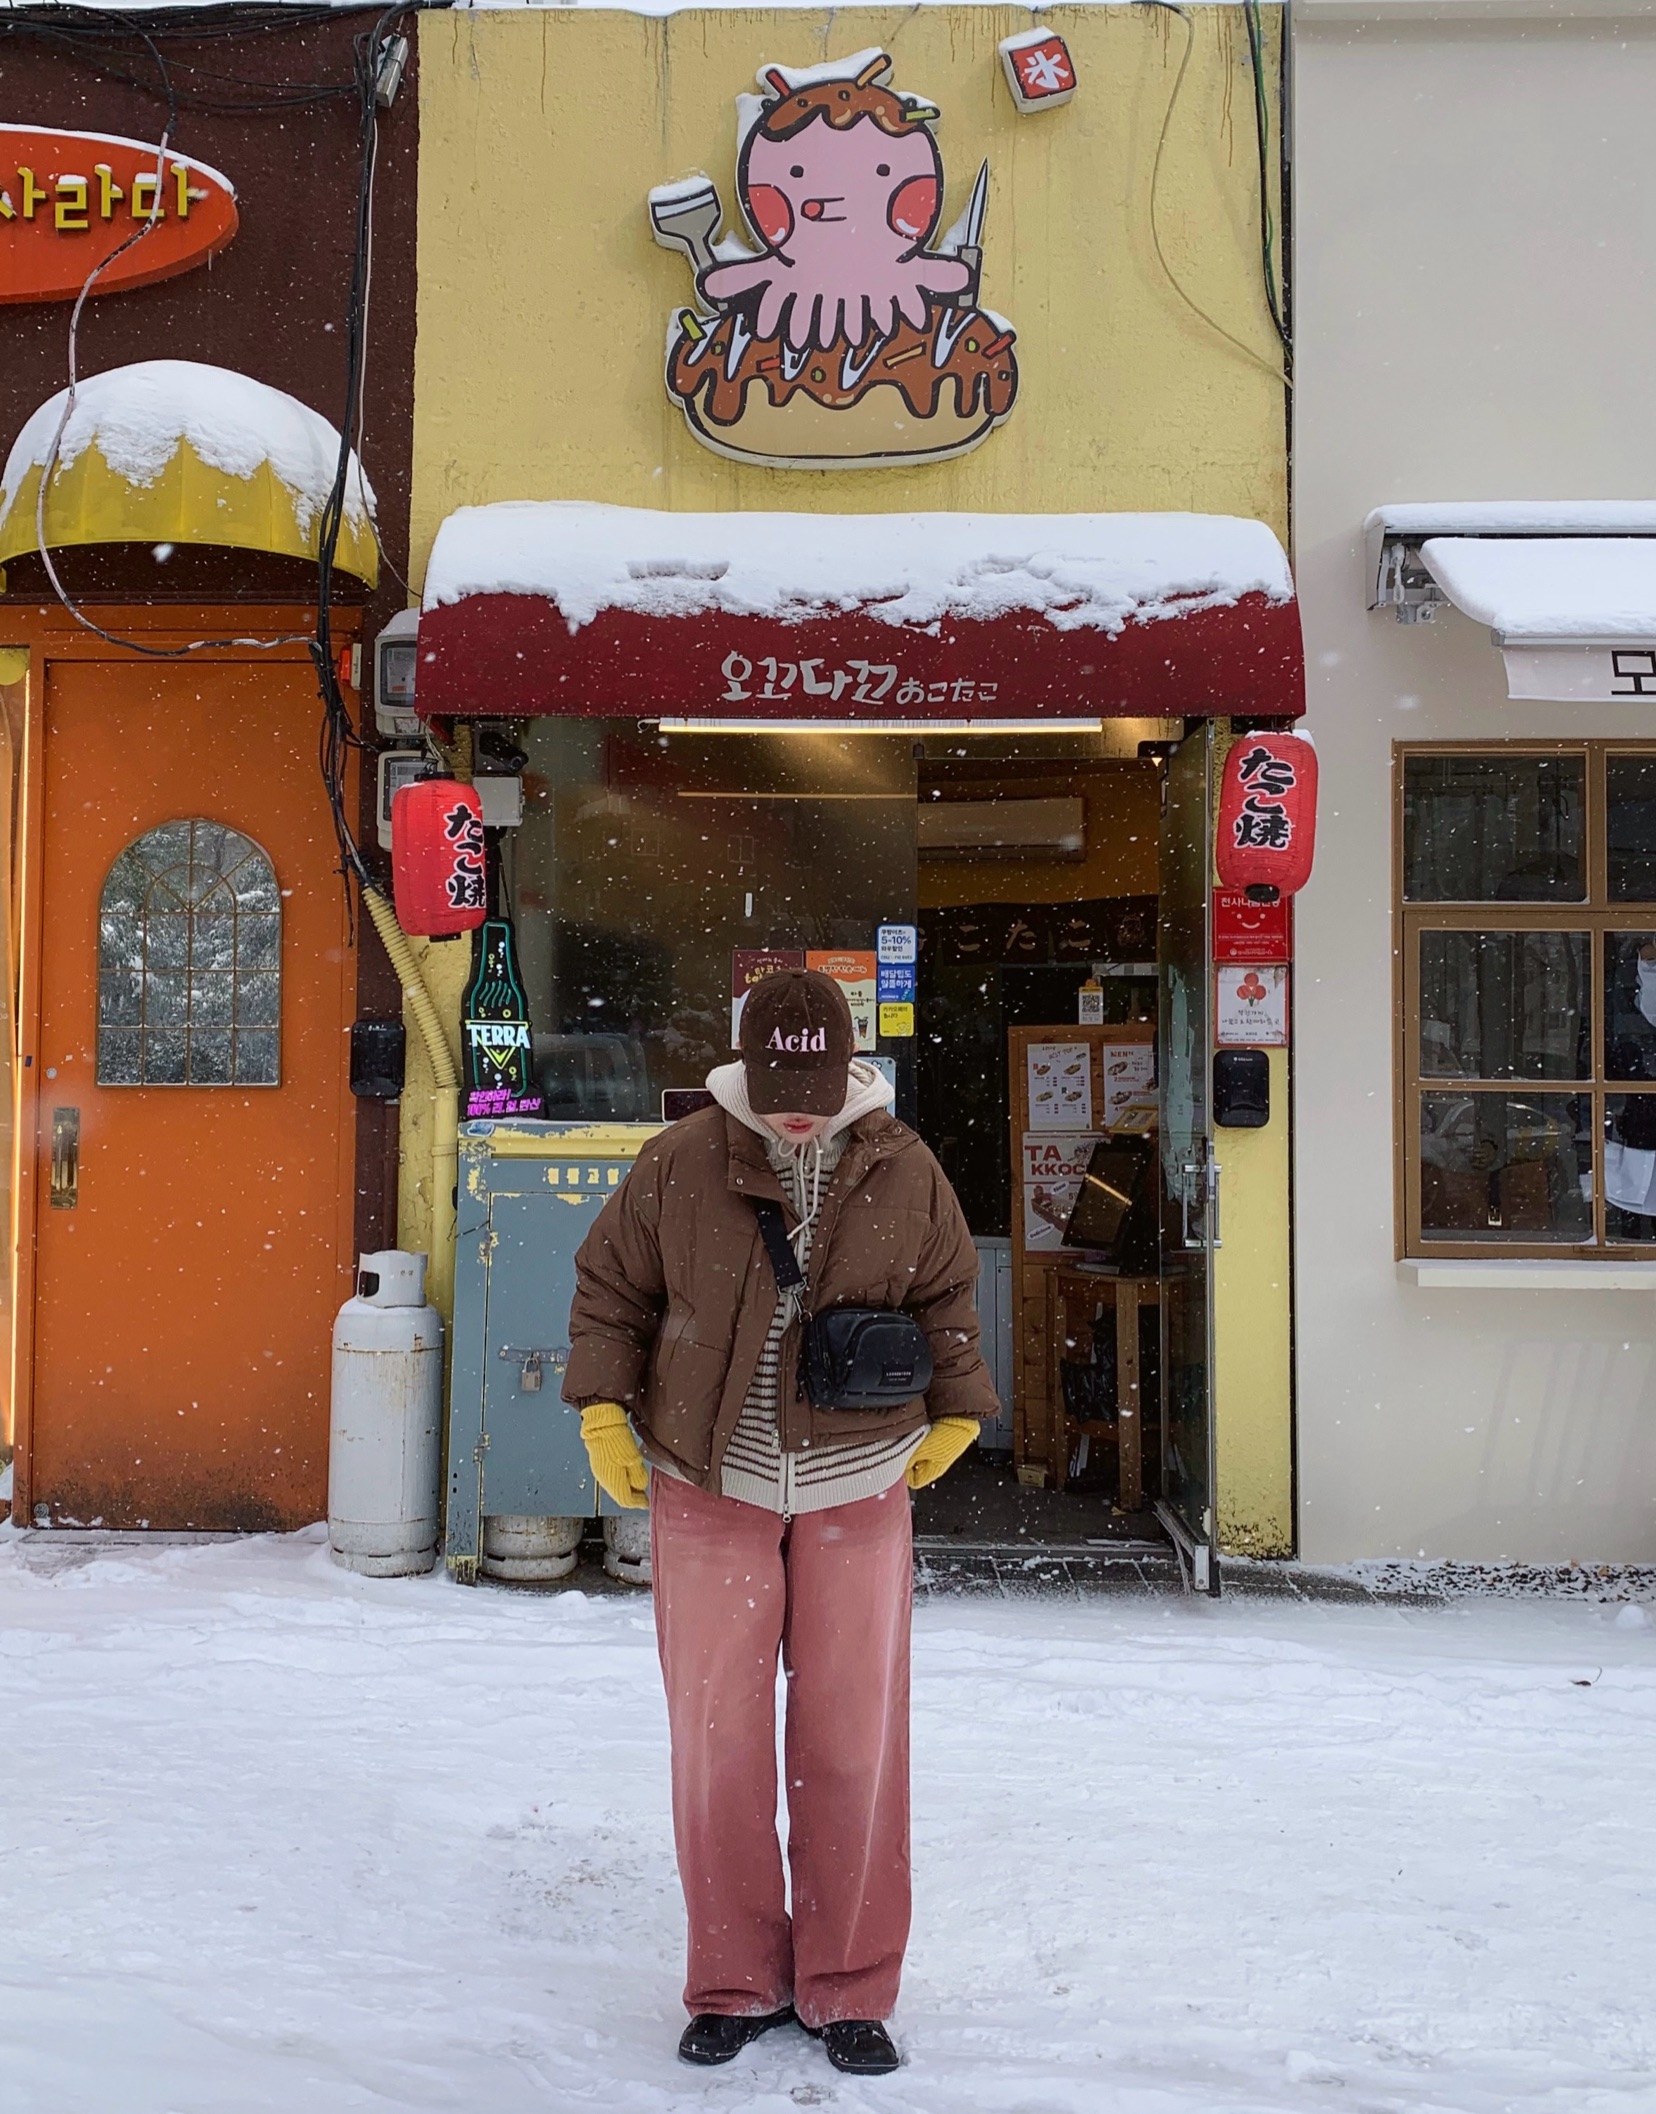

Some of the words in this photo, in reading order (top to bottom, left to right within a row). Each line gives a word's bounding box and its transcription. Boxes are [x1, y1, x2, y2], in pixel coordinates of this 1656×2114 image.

[721, 650, 898, 705] 오꼬다꼬
[1233, 746, 1296, 849] たこ焼
[466, 1024, 531, 1049] TERRA
[765, 1026, 828, 1052] Acid
[1024, 1145, 1062, 1161] TA
[1031, 1163, 1087, 1176] KKOC
